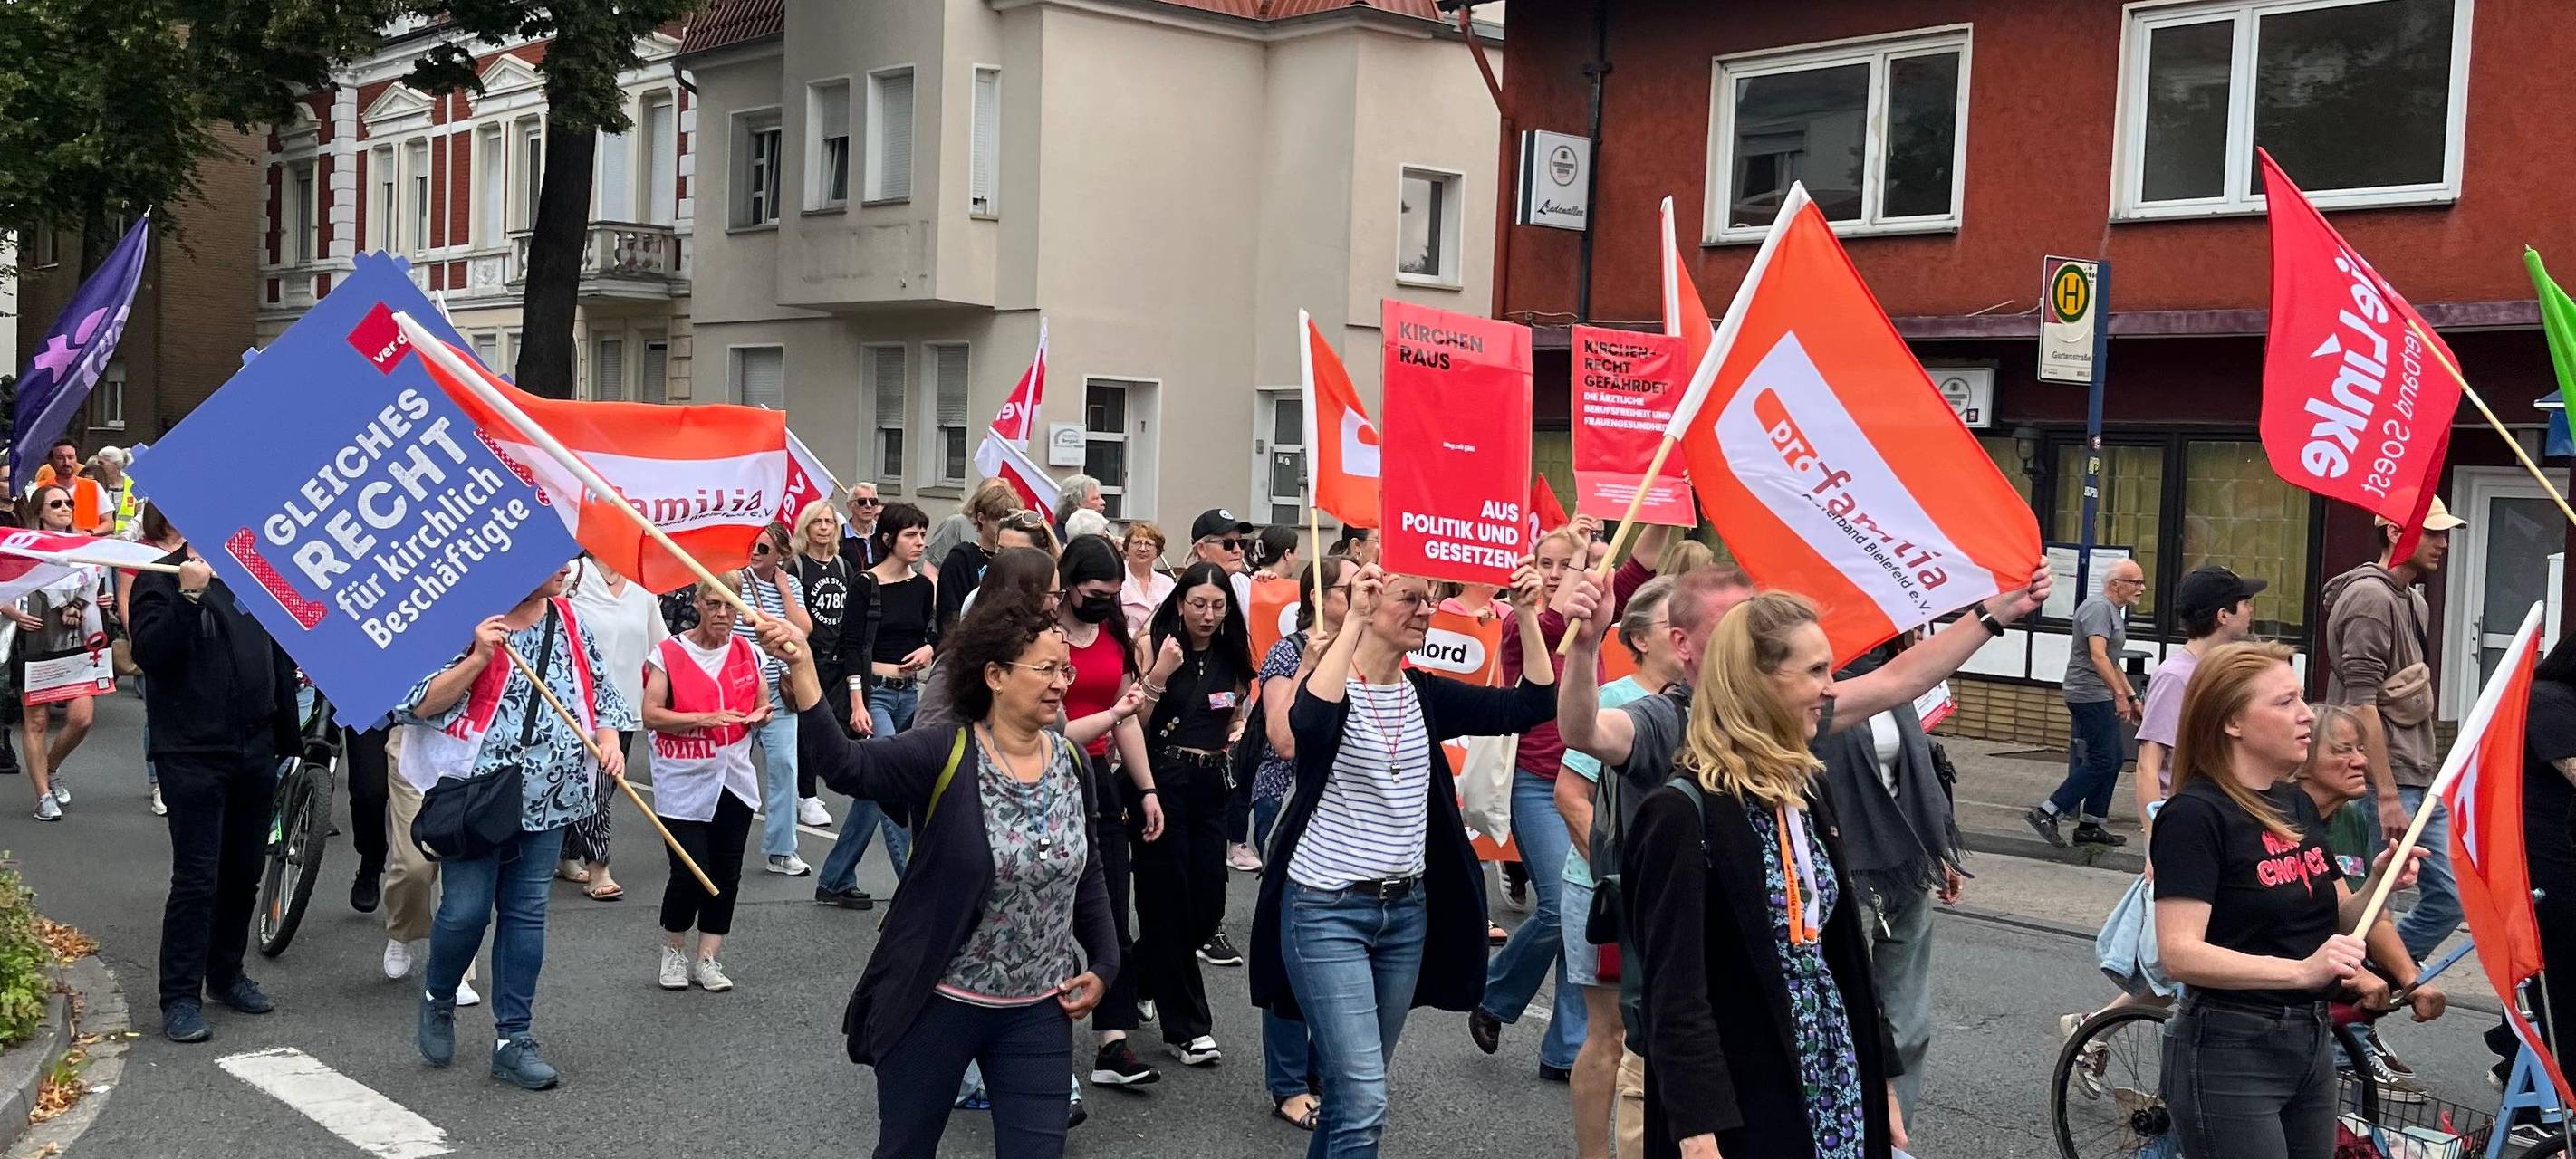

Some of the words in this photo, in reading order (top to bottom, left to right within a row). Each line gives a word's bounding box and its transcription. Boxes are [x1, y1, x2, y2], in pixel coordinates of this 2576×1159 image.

[2063, 277, 2079, 310] H
[1399, 321, 1484, 353] KIRCHEN
[1584, 340, 1657, 358] KIRCHEN-
[1399, 346, 1450, 370] RAUS
[1584, 358, 1630, 373] RECHT
[1583, 392, 1598, 401] DIE
[1584, 374, 1668, 395] GEFÄHRDET
[1769, 418, 1812, 473] pro
[264, 388, 429, 546] GLEICHES
[292, 416, 467, 590] RECHT
[1480, 499, 1519, 522] AUS
[335, 572, 387, 621] für
[373, 466, 505, 582] kirchlich
[1401, 511, 1474, 540] POLITIK
[1477, 524, 1520, 546] UND
[1424, 540, 1519, 570] GESETZEN
[1863, 542, 1914, 589] Bielefeld
[360, 498, 530, 650] Beschäftigte
[656, 738, 716, 759] SOZIAL
